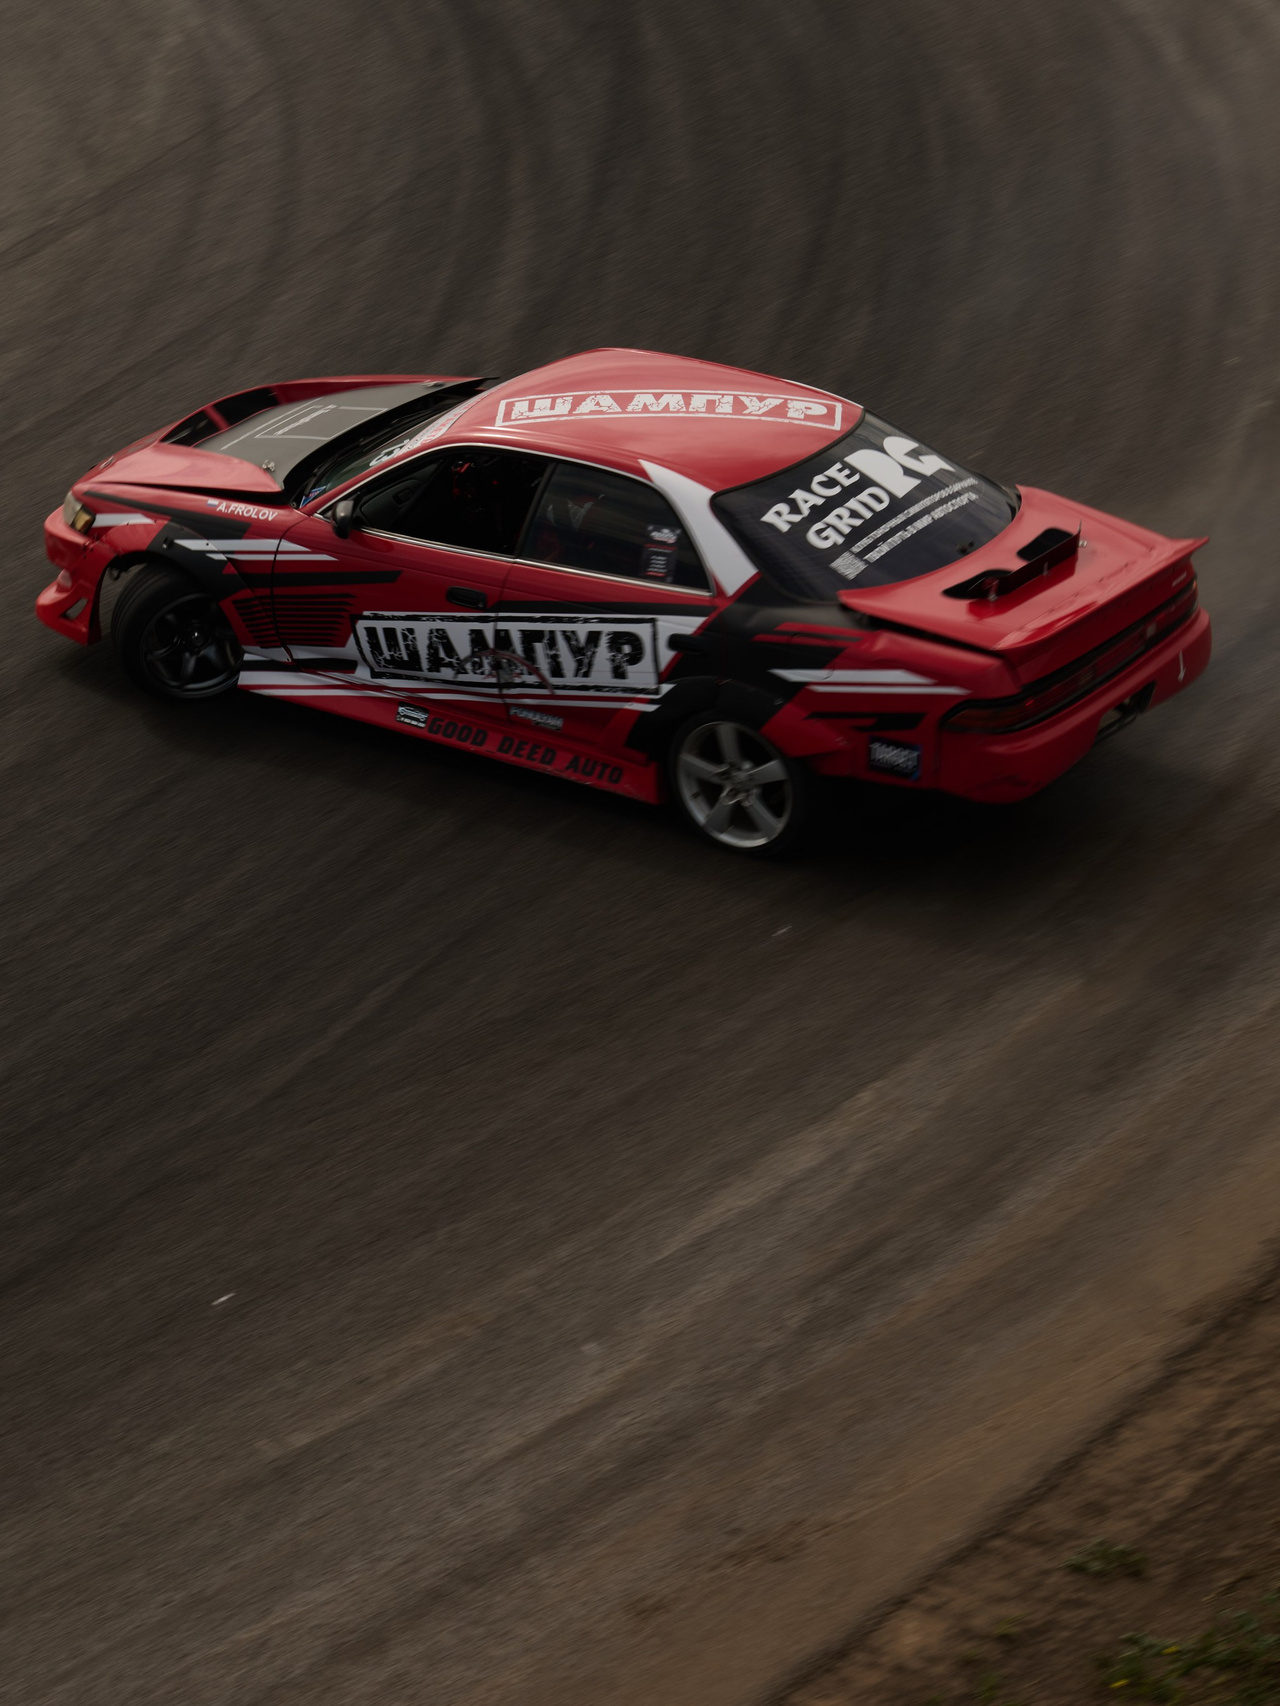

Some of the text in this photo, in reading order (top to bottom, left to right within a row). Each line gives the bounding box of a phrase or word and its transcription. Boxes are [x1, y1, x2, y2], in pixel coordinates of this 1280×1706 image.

[511, 393, 827, 419] ШАМПУР
[216, 503, 278, 521] A.FROLOV
[759, 461, 860, 533] RACE
[805, 485, 890, 549] GRID
[364, 626, 644, 680] ШАМПУР
[427, 717, 488, 748] GOOD
[496, 736, 558, 766] DEED
[565, 756, 624, 785] AUTO
